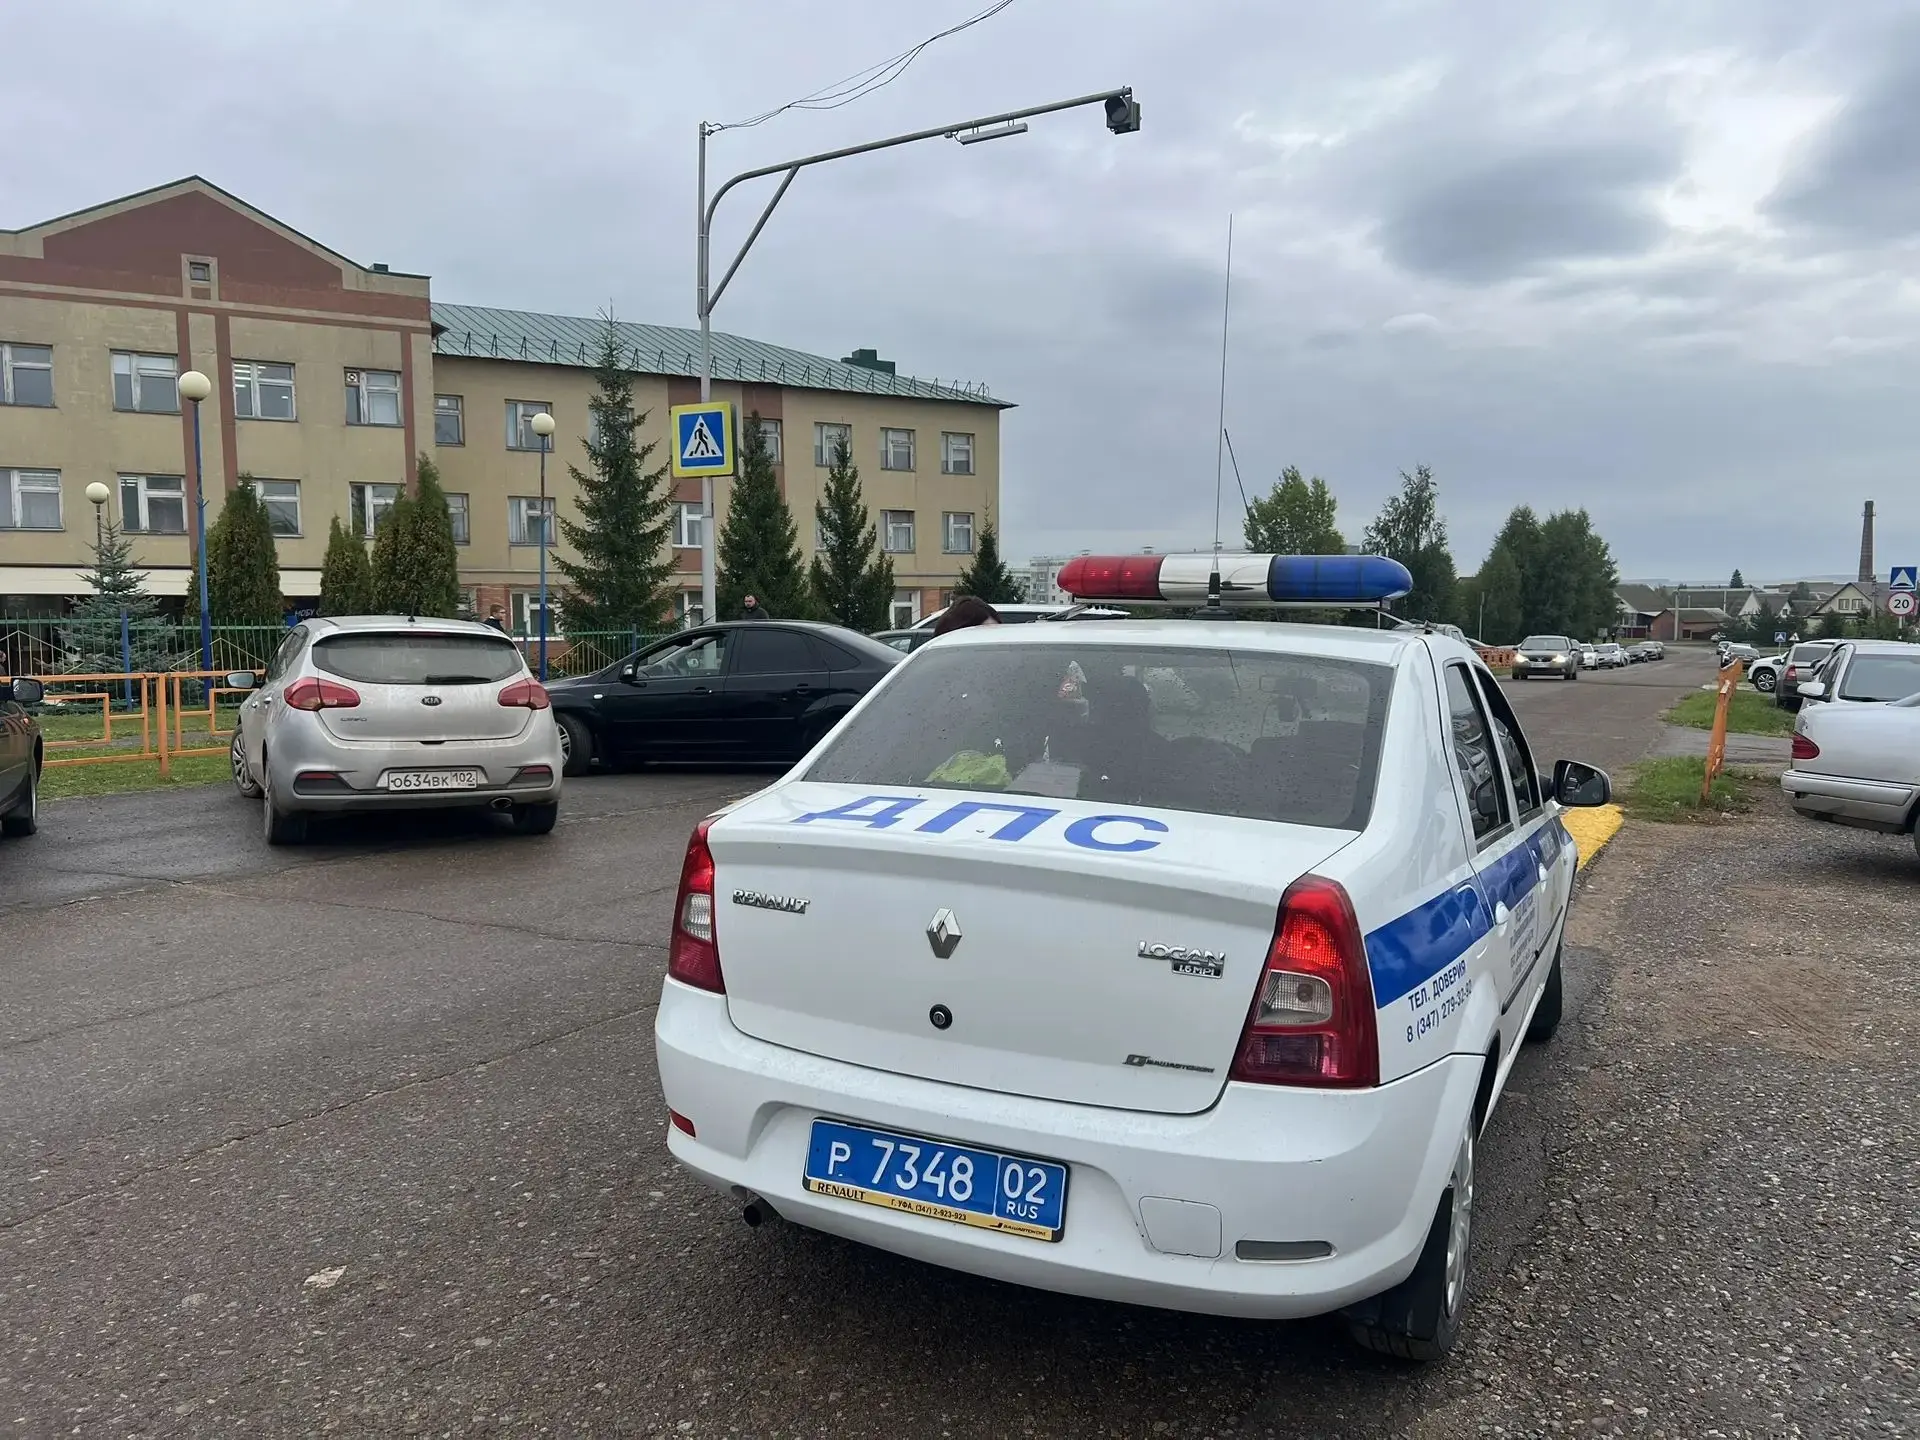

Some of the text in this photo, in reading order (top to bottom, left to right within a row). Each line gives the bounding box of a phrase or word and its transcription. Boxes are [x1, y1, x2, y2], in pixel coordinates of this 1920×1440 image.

[1893, 599, 1910, 609] 20
[422, 696, 441, 705] KIA
[452, 772, 474, 783] 102
[790, 795, 1169, 852] ДПС
[732, 888, 811, 914] RENAULT
[1137, 940, 1225, 968] LOGAN
[1407, 959, 1467, 1011] ТЕЛ. ДОВЕРИЯ
[1406, 1025, 1414, 1043] 8
[1416, 1008, 1440, 1040] (347)
[871, 1138, 975, 1202] 7348
[1003, 1162, 1048, 1205] 02
[817, 1182, 867, 1202] RENAULT
[915, 1203, 932, 1214] (347)
[933, 1207, 967, 1222] 2-923-923
[1005, 1201, 1039, 1220] RUS
